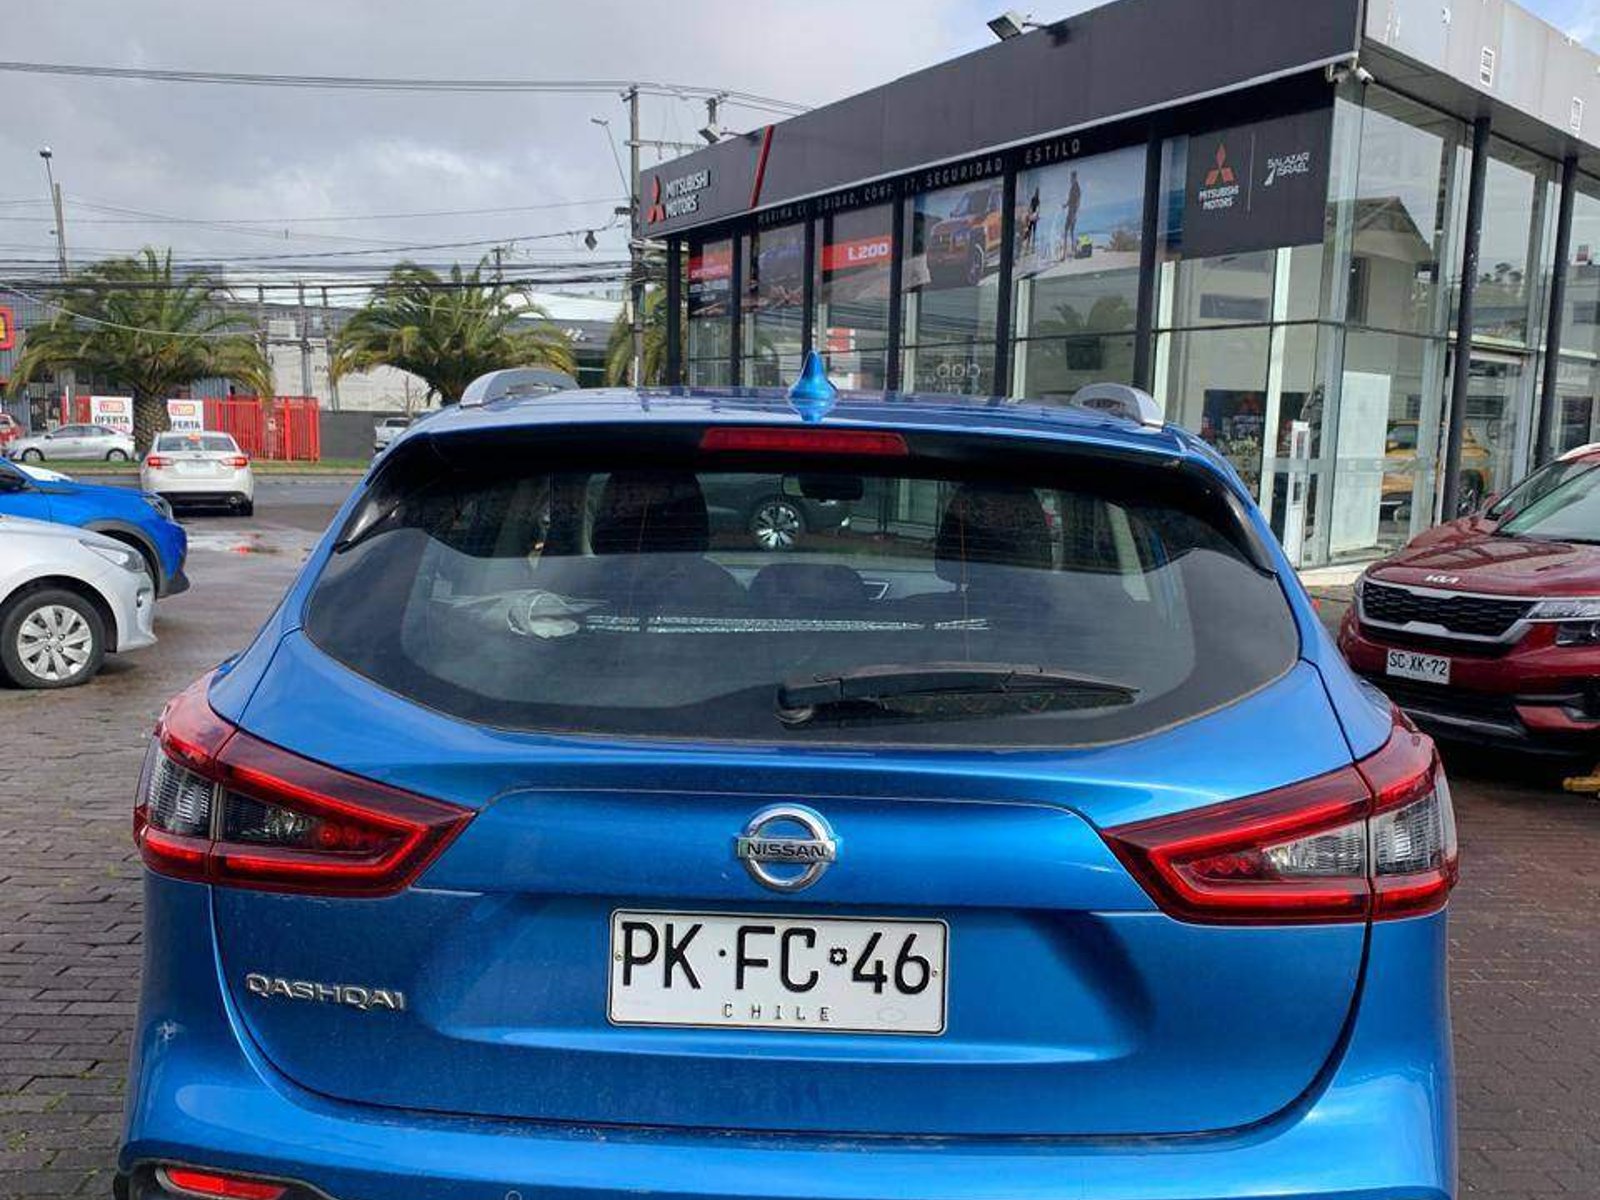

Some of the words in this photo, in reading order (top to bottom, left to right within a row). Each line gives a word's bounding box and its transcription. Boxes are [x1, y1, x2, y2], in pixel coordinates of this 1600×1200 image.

[1025, 139, 1080, 164] ESTILO
[666, 169, 711, 199] MITSUBISHI
[1200, 185, 1240, 201] MITSUBISHI
[666, 194, 699, 219] MOTORS
[1203, 198, 1233, 211] MOTORS
[848, 243, 888, 261] L200
[94, 415, 130, 425] OFERTA
[747, 843, 826, 858] NISSAN
[245, 972, 406, 1010] QASHQAI
[721, 1002, 831, 1022] CHILE
